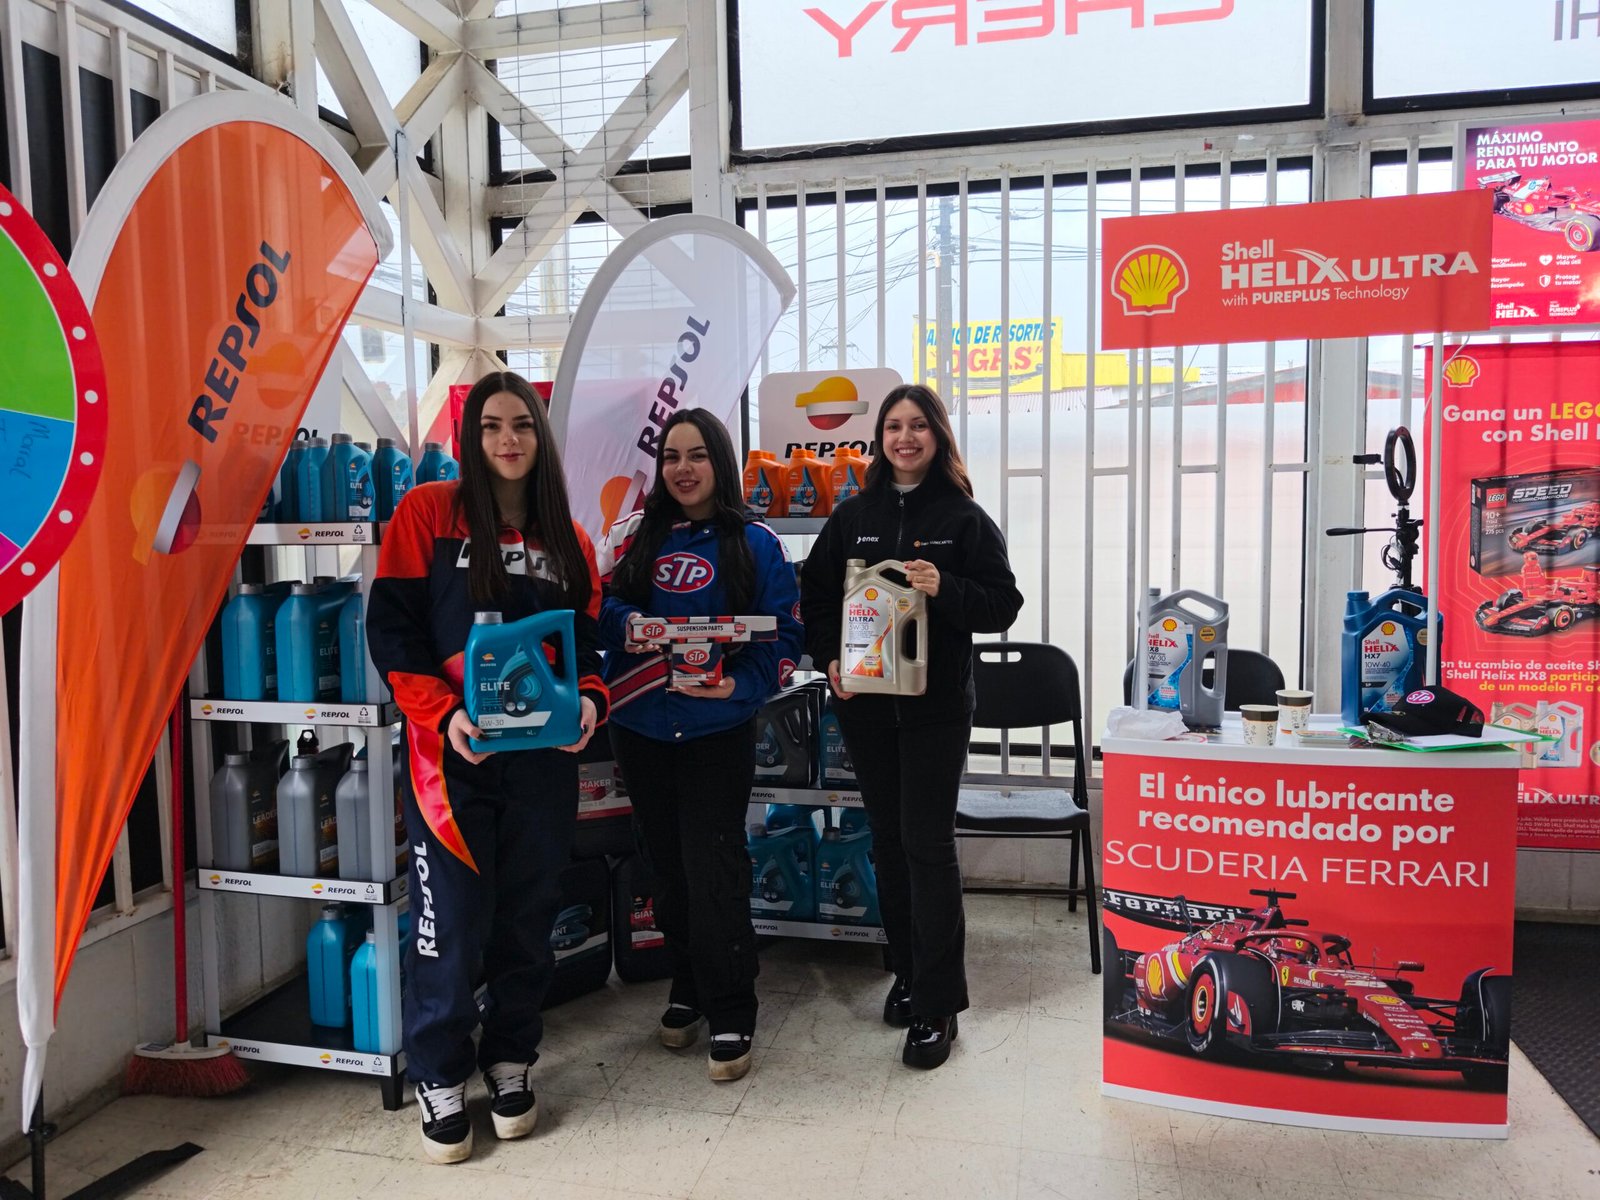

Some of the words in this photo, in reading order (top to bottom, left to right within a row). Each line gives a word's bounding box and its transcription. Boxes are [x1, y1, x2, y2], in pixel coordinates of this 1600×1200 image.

[1476, 131, 1543, 145] MÁXIMO
[1476, 141, 1579, 158] RENDIMIENTO
[1476, 158, 1517, 170] PARA
[1520, 156, 1538, 167] TU
[1542, 152, 1598, 166] MOTOR
[1221, 239, 1274, 261] Shell
[1220, 248, 1350, 290] HELIX
[1352, 251, 1479, 282] ULTRA
[1222, 294, 1249, 307] with
[1252, 287, 1331, 305] PUREPLUS
[1334, 283, 1410, 300] Technology
[1495, 306, 1540, 318] HELIX
[973, 325, 991, 344] DE
[188, 240, 291, 443] REPSOL
[1443, 405, 1506, 422] Gana
[1513, 408, 1542, 421] un
[1550, 402, 1600, 420] LEG
[1482, 429, 1522, 442] con
[1530, 423, 1588, 441] Shell
[1512, 484, 1572, 499] SPEED
[1488, 494, 1505, 502] LEGO
[314, 530, 345, 538] REPSOL
[656, 556, 708, 587] STP
[849, 606, 880, 616] HELIX
[645, 626, 662, 636] STP
[1364, 642, 1400, 653] HELIX
[688, 652, 705, 661] STP
[1458, 660, 1471, 669] tu
[1475, 659, 1523, 670] cambio
[1525, 660, 1543, 670] de
[1545, 660, 1584, 670] aceite
[1446, 669, 1478, 679] Shell
[1481, 671, 1515, 680] Helix
[1519, 671, 1547, 681] HX8
[1550, 672, 1599, 684] particip
[480, 682, 511, 692] ELITE
[1479, 681, 1496, 691] de
[1499, 683, 1515, 691] un
[1518, 682, 1567, 692] modelo
[1570, 683, 1582, 692] F1
[1408, 691, 1431, 701] STP
[216, 707, 244, 715] REPSOL
[579, 779, 612, 789] MAKER
[1139, 772, 1165, 798] El
[1175, 775, 1265, 806] único
[1276, 779, 1454, 812] lubricante
[1517, 787, 1557, 804] ELIX
[1558, 794, 1600, 805] ULTR
[1138, 810, 1382, 843] recomendado
[1392, 823, 1455, 851] por
[1105, 840, 1308, 882] SCUDERIA
[1322, 858, 1488, 887] FERRARI
[225, 878, 252, 887] REPSOL
[820, 881, 840, 889] ELITE
[328, 886, 356, 895] REPSOL
[414, 841, 439, 958] REPSOL
[634, 910, 654, 920] GIAN
[233, 1044, 260, 1054] REPSOL
[335, 1057, 364, 1066] REPSOL
